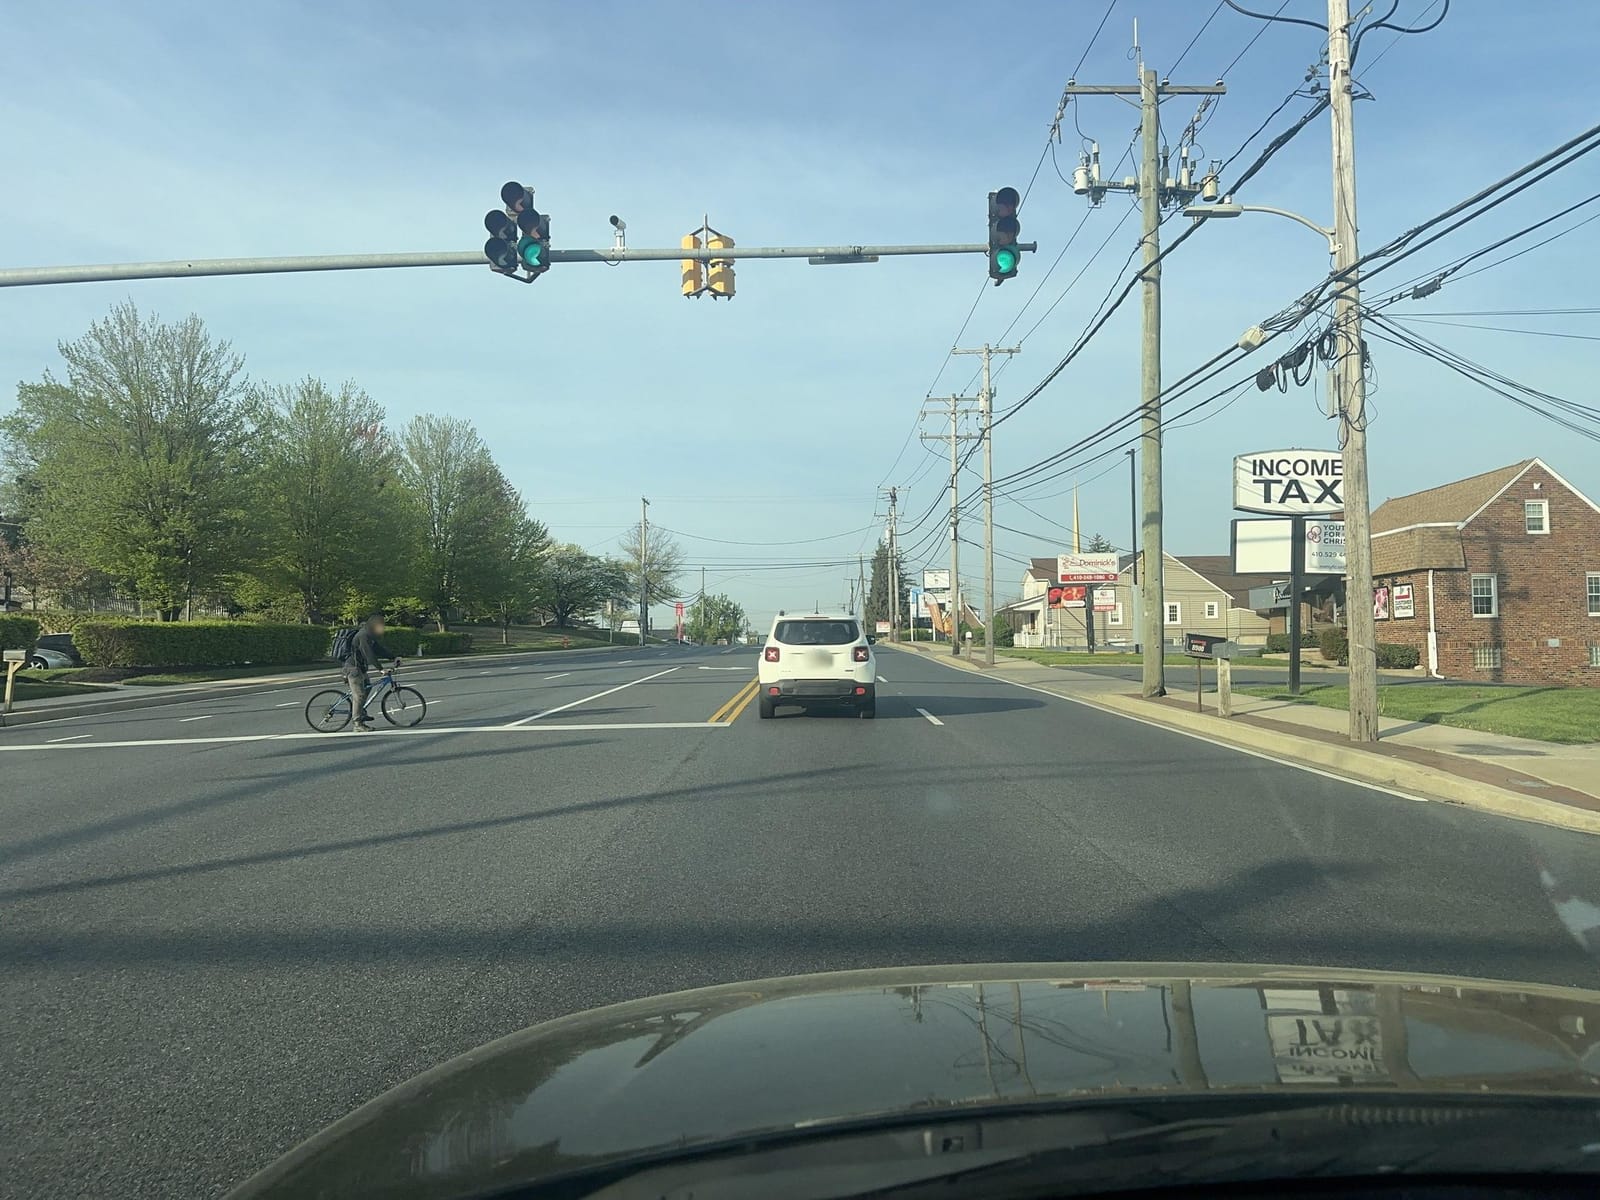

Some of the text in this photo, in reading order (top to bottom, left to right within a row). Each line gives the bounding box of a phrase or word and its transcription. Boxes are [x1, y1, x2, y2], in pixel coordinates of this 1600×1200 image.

[1252, 459, 1343, 476] INCOME
[1252, 479, 1344, 504] TAX
[1079, 558, 1116, 567] Dominick's
